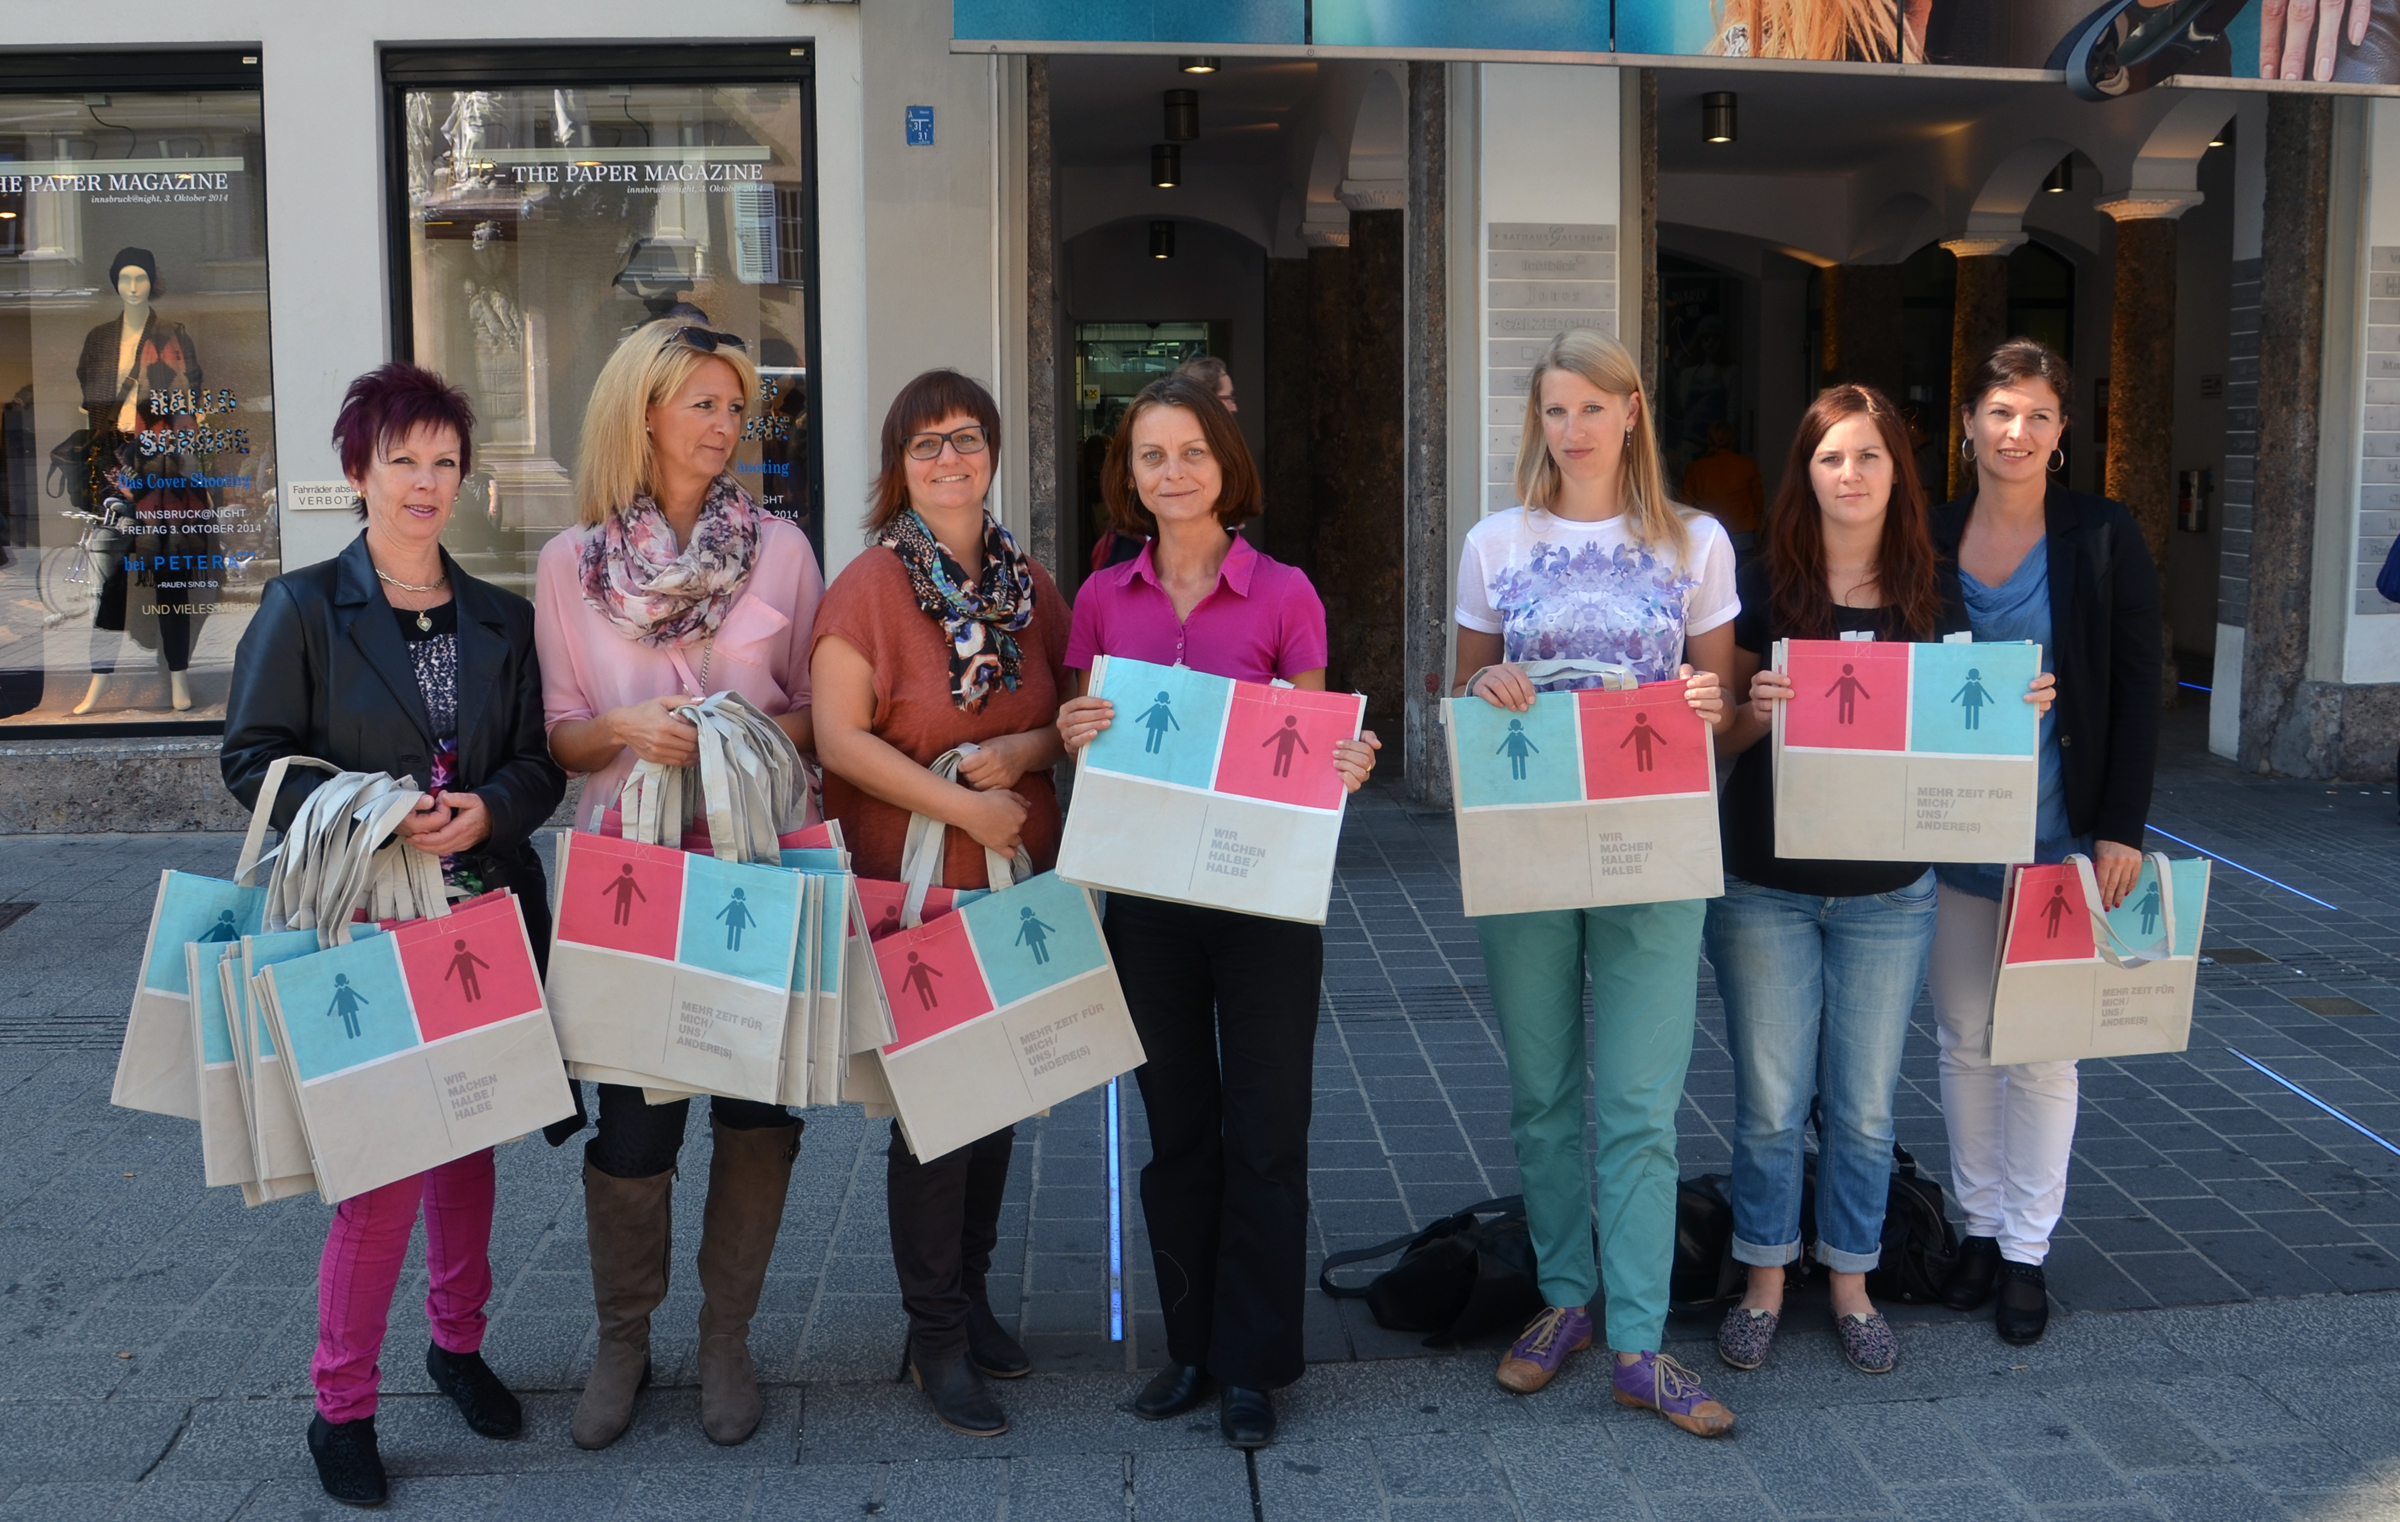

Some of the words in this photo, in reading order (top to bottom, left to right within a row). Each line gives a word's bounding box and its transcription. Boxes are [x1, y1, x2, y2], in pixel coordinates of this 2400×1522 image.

[512, 165, 559, 183] THE
[566, 165, 638, 183] PAPER
[644, 164, 763, 182] MAGAZINE
[29, 174, 102, 192] PAPER
[108, 173, 228, 191] MAGAZINE
[164, 194, 172, 202] 3.
[174, 194, 206, 202] Oktober
[208, 193, 228, 202] 2014
[150, 389, 237, 415] HALLO
[736, 458, 789, 478] hooting
[118, 474, 143, 490] Das
[147, 473, 187, 489] Cover
[190, 472, 252, 491] Shooting
[293, 485, 332, 494] Fahrräder
[135, 508, 247, 520] INNSBRUCK@NIGHT
[122, 525, 168, 535] FREITAG
[170, 525, 179, 534] 3.
[182, 524, 234, 534] OKTOBER
[237, 523, 262, 533] 2014
[124, 556, 145, 572] bei
[142, 603, 171, 616] UND
[176, 603, 215, 615] VIELES
[1917, 787, 1953, 797] MEHR
[1957, 788, 1985, 799] ZEIT
[1988, 788, 2013, 799] FÜR
[1916, 820, 1981, 833] ANDERE(S)
[1214, 828, 1238, 841] WIR
[1599, 832, 1623, 842] WIR
[1211, 839, 1266, 858] MACHEN
[1600, 841, 1653, 853] MACHEN
[1206, 862, 1249, 878] HALBE
[1602, 865, 1643, 876] HALBE
[2102, 987, 2128, 997] MEHR
[2131, 986, 2152, 995] ZEIT
[2155, 984, 2174, 995] FÜR
[681, 1001, 714, 1017] MEHR
[715, 1009, 739, 1024] ZEIT
[741, 1016, 763, 1031] FÜR
[2100, 1016, 2148, 1027] ANDERE(S)
[1019, 1024, 1053, 1045] MEHR
[1054, 1013, 1079, 1031] ZEIT
[1081, 1003, 1105, 1019] FÜR
[676, 1036, 732, 1060] ANDERE(S)
[1033, 1045, 1091, 1077] ANDERE(S)
[443, 1071, 468, 1086] WIR
[447, 1073, 498, 1098] MACHEN
[454, 1100, 493, 1121] HALBE
